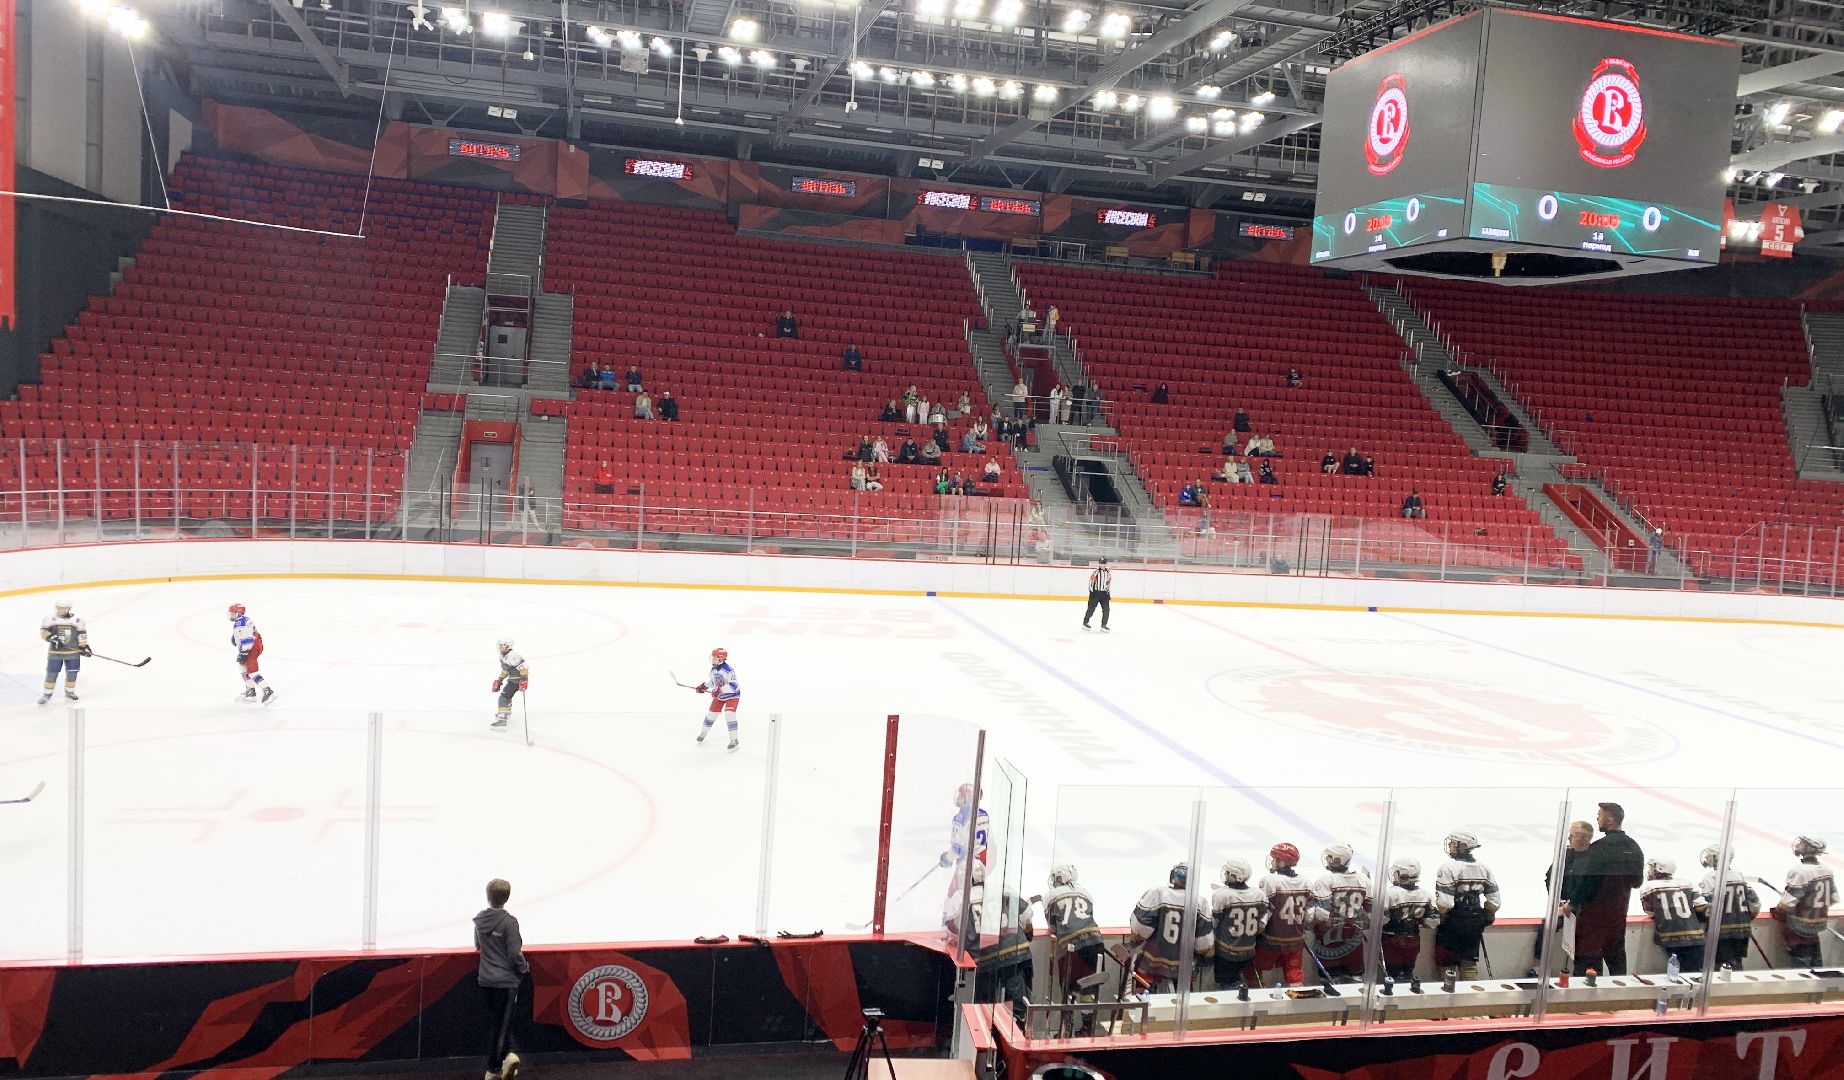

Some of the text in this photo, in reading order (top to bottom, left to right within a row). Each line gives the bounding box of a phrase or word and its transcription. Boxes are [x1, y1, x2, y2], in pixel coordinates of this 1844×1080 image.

[1406, 198, 1420, 222] 0
[1538, 194, 1559, 220] 0
[1579, 210, 1619, 229] 20:00
[1642, 206, 1662, 231] 0
[1344, 212, 1357, 235] 0
[1774, 224, 1784, 242] 5
[1582, 241, 1612, 253] период
[1656, 890, 1693, 921] 10
[1724, 885, 1749, 914] 72
[1813, 879, 1831, 909] 21
[1057, 896, 1091, 926] 78
[1228, 907, 1259, 938] 36
[1279, 895, 1308, 926] 43
[1163, 910, 1182, 945] 6
